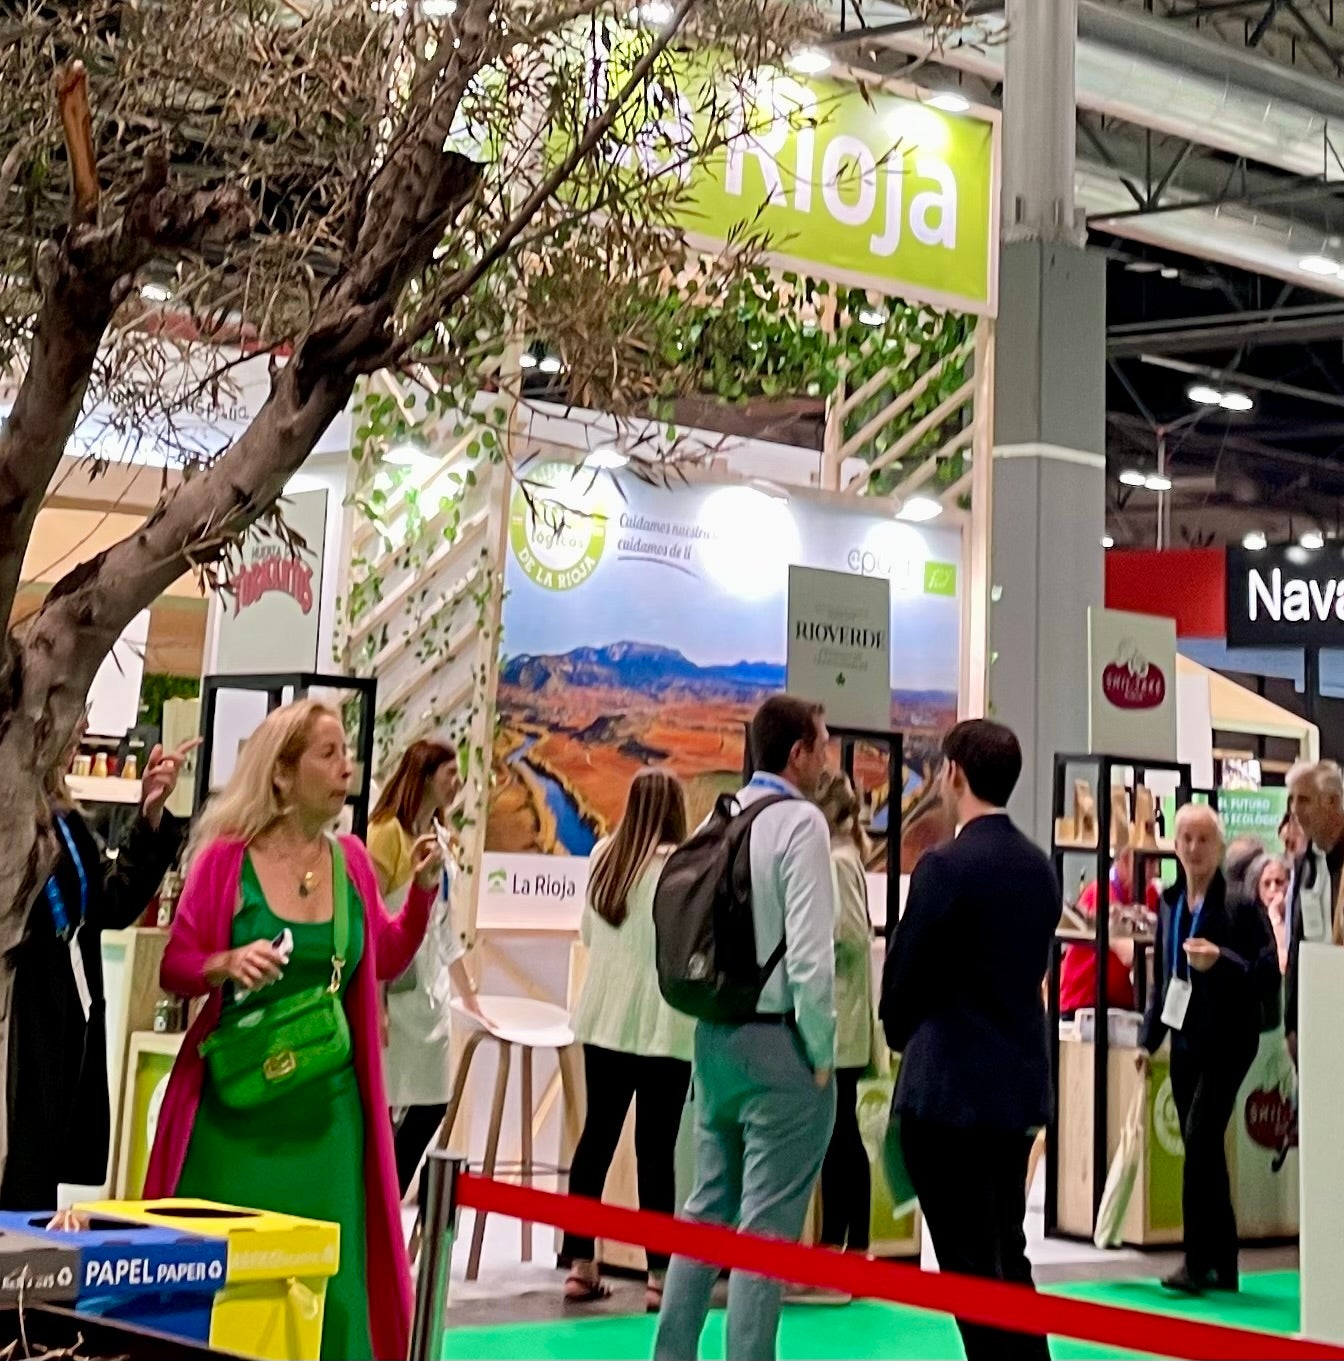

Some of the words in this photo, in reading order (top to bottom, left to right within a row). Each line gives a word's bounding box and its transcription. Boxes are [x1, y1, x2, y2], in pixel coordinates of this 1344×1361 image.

[724, 68, 958, 258] Rioja
[619, 512, 671, 535] Cuidamos
[617, 539, 668, 557] cuidamos
[669, 541, 682, 560] de
[535, 565, 553, 588] LA
[557, 557, 596, 589] RIOJA
[795, 620, 887, 652] RIOVERDE
[1230, 798, 1271, 810] FUTURO
[513, 872, 530, 895] La
[535, 872, 576, 901] Rioja
[86, 1258, 154, 1287] PAPEL
[156, 1261, 207, 1283] PAPER
